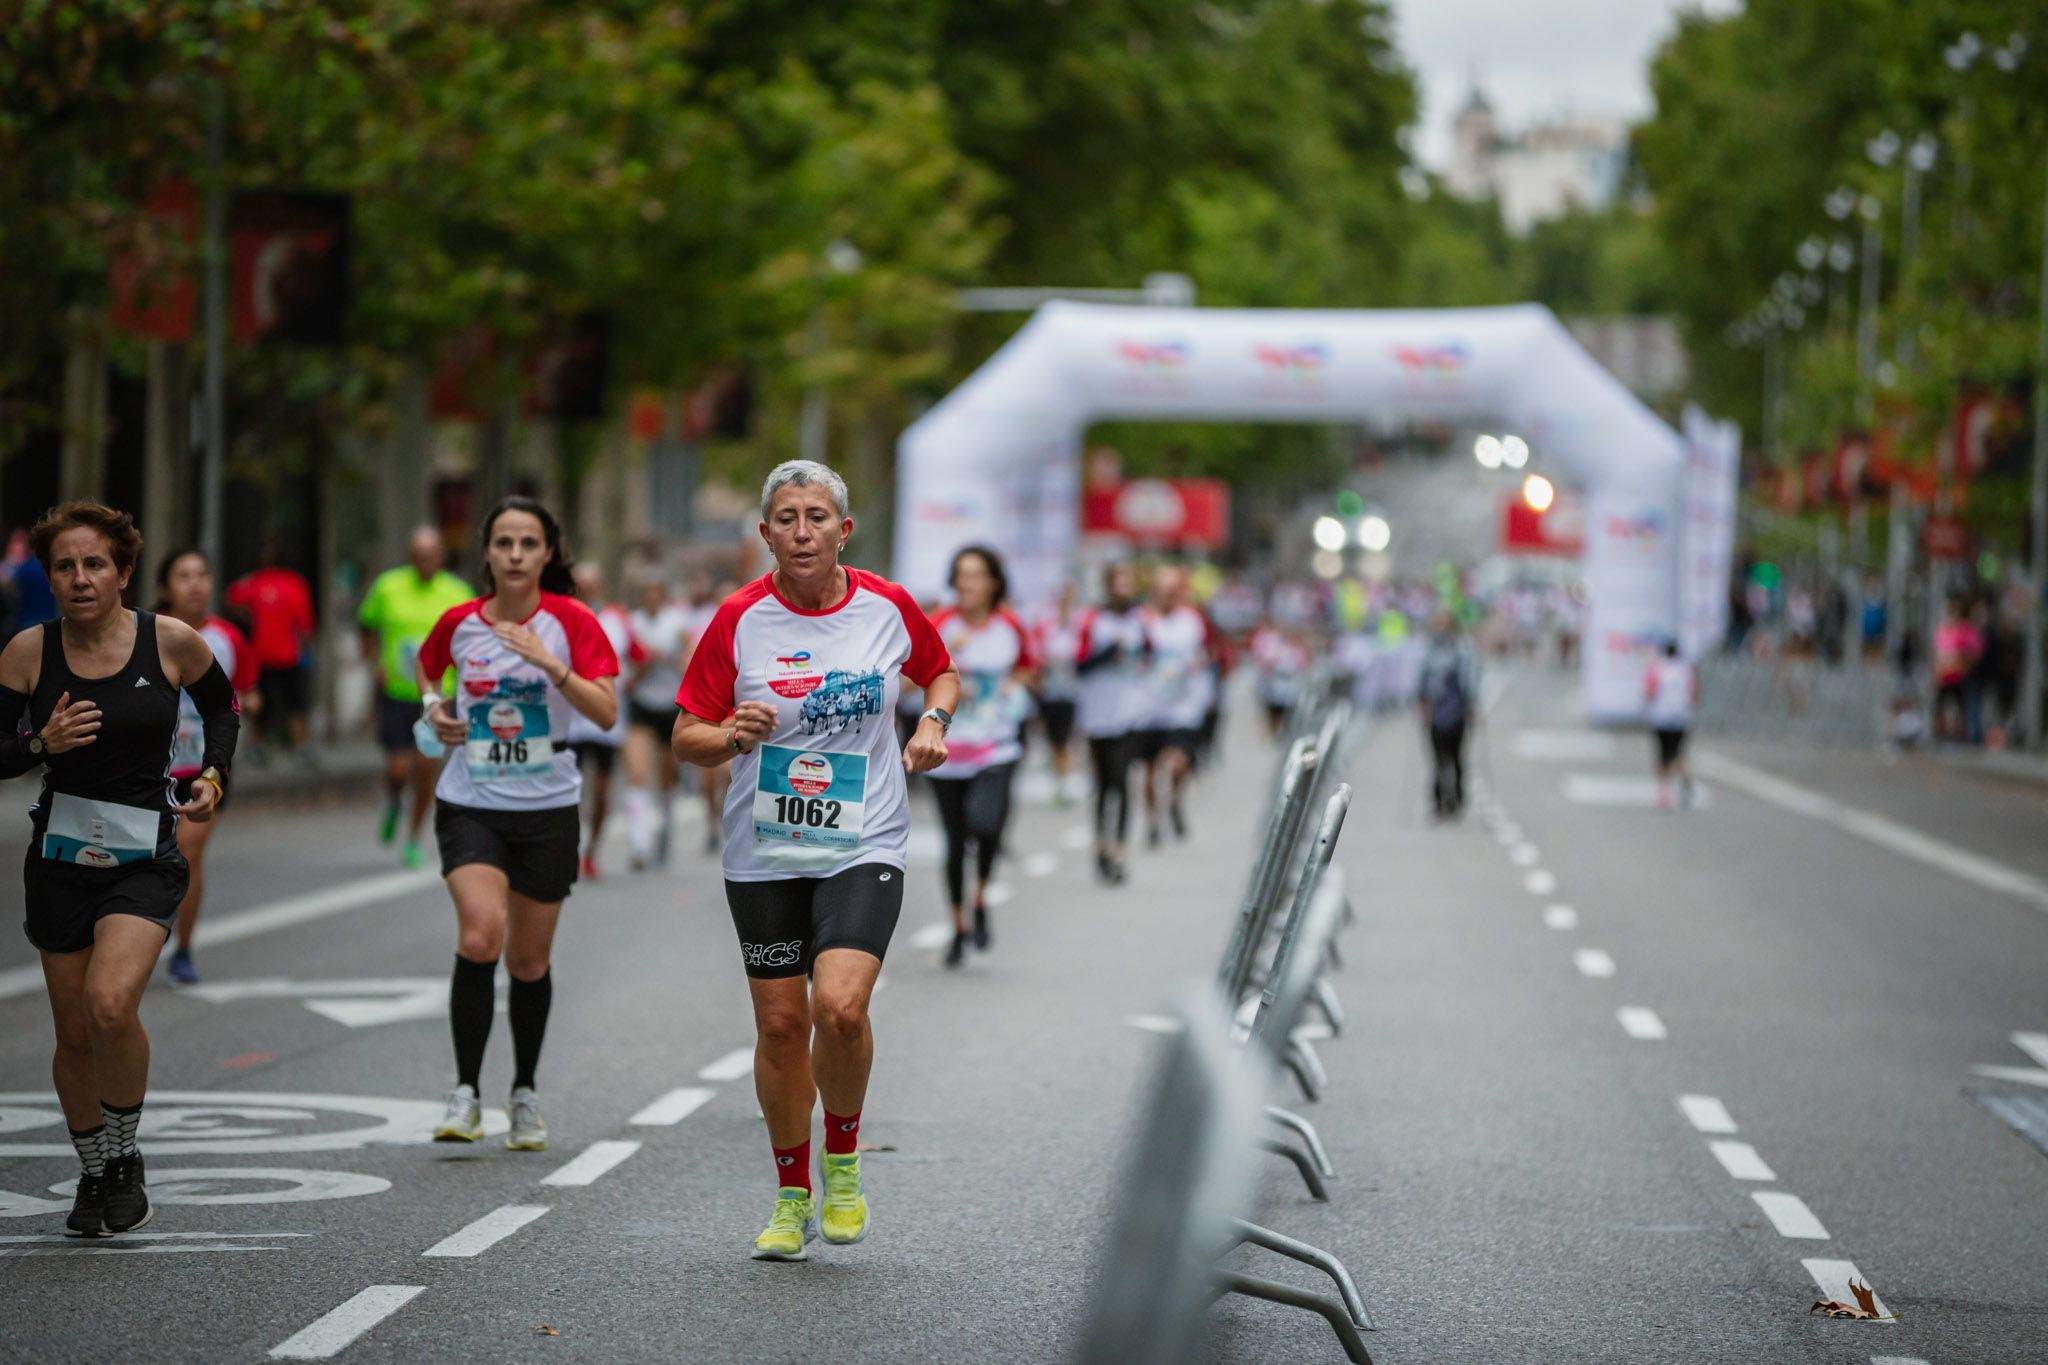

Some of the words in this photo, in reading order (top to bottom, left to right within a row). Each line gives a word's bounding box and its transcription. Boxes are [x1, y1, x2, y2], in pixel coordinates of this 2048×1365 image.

[488, 741, 528, 764] 476
[775, 796, 841, 829] 1062
[742, 940, 801, 966] SICS
